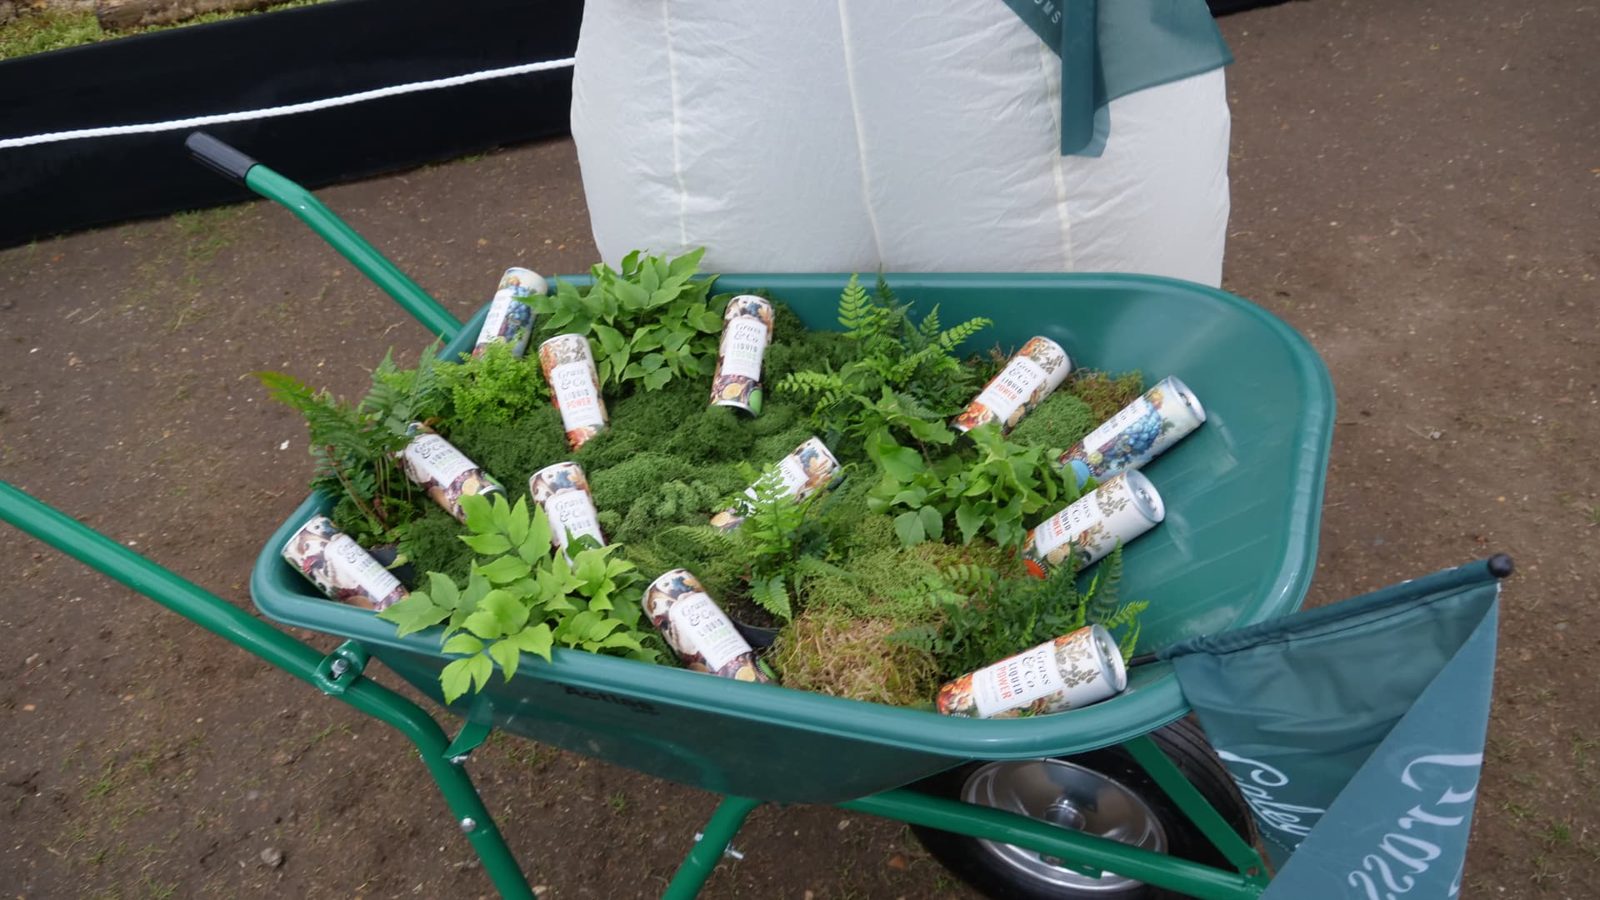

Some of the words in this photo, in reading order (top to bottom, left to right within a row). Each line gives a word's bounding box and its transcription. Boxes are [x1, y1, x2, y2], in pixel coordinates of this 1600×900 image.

[1008, 661, 1024, 696] LIQUID
[1021, 655, 1036, 670] &
[1023, 669, 1036, 689] Co
[1037, 650, 1052, 686] Grass
[996, 665, 1013, 700] POWER
